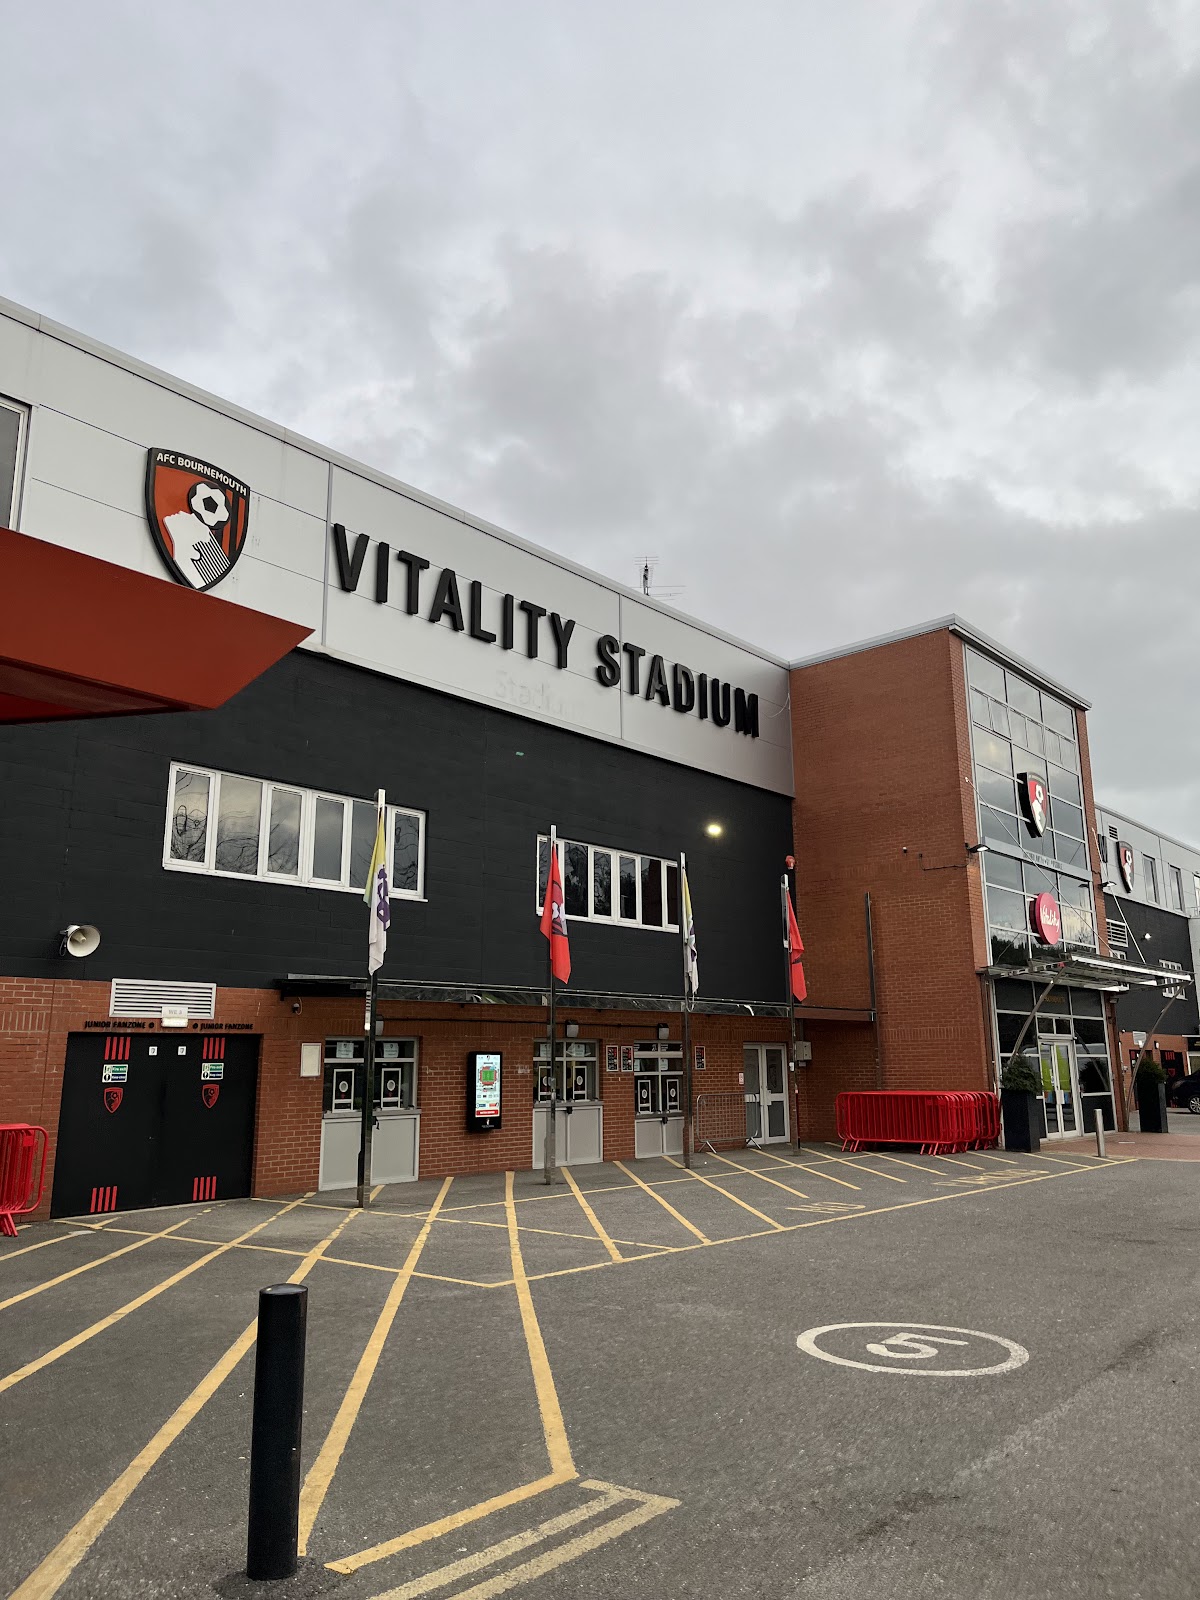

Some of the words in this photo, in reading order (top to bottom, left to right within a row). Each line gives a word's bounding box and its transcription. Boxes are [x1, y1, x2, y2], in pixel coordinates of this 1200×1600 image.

[156, 452, 176, 465] AFC
[177, 456, 248, 497] BOURNEMOUTH
[334, 523, 577, 670] VITALITY
[596, 634, 760, 739] STADIUM
[84, 1020, 111, 1029] JUNIOR
[112, 1020, 147, 1029] FANZONE
[200, 1022, 224, 1031] JUNIOR
[224, 1022, 254, 1030] FANZONE
[866, 1332, 969, 1359] 5
